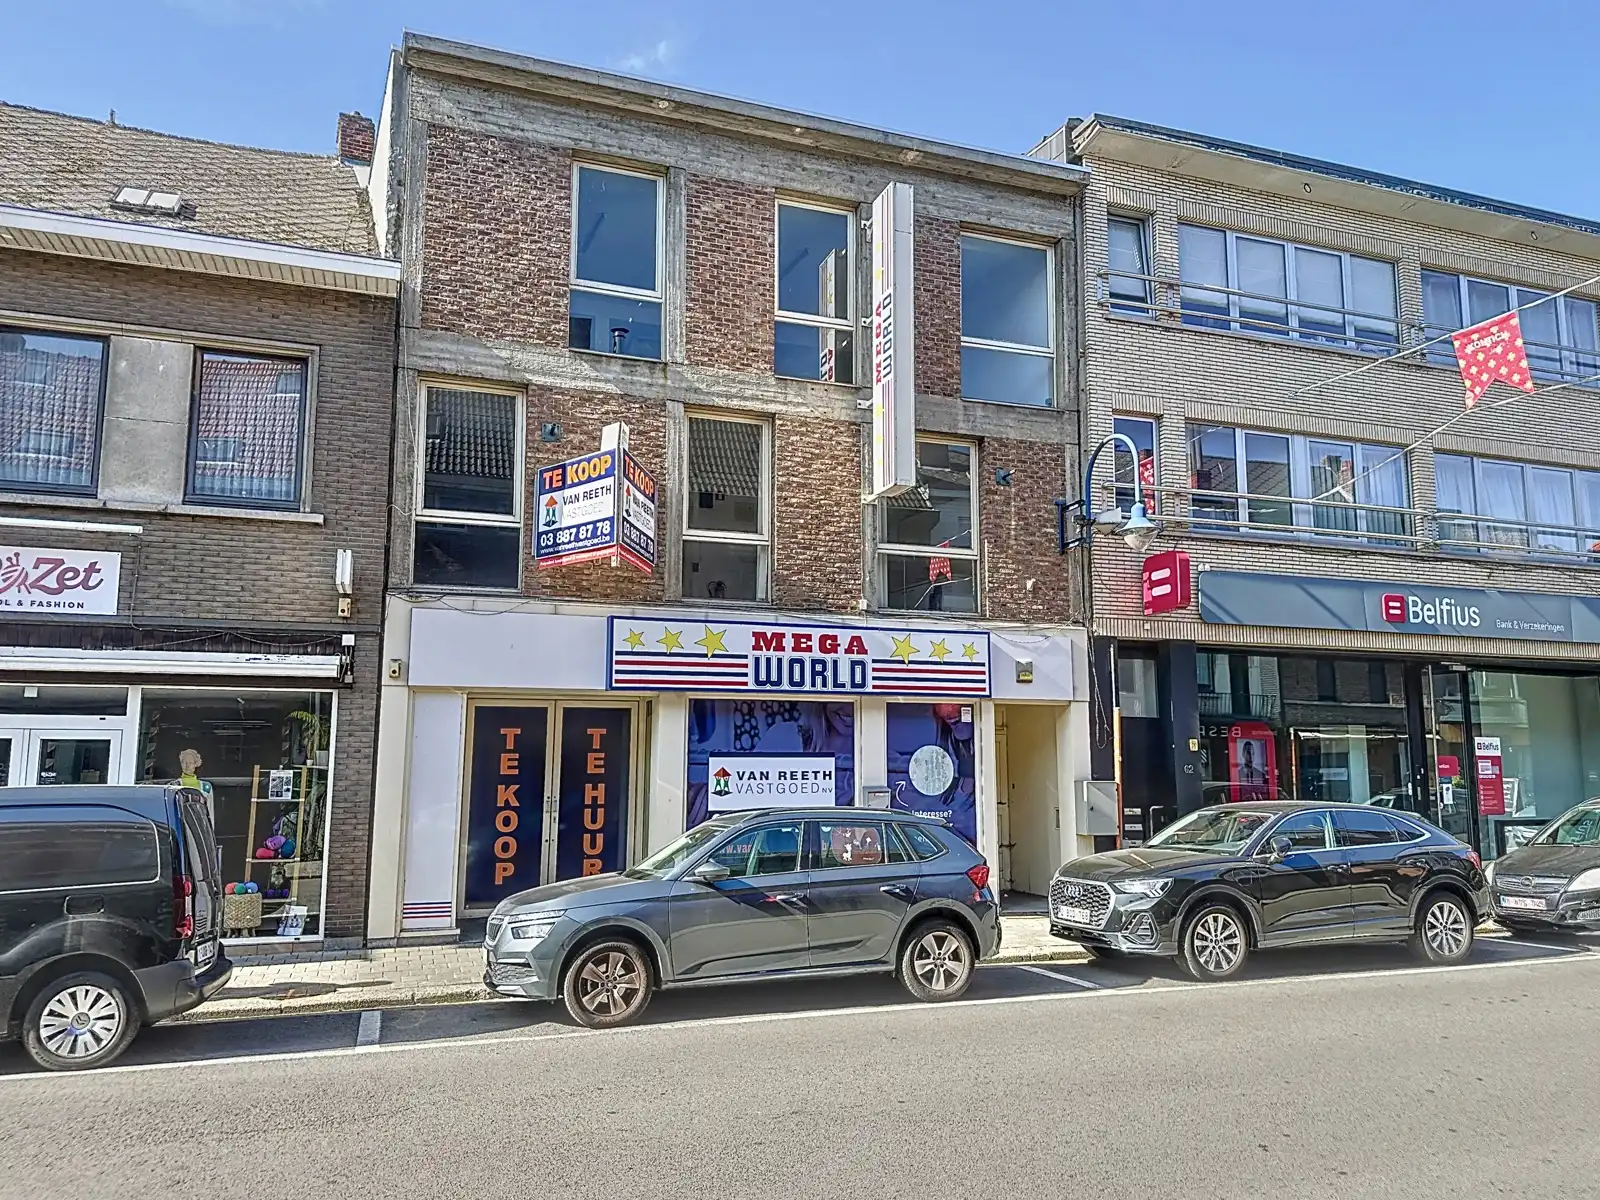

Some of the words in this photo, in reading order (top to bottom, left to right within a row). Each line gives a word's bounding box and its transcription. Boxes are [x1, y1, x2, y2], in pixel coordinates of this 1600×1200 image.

[882, 293, 892, 378] WORLD
[543, 469, 563, 490] TE
[567, 455, 612, 485] KOOP
[624, 455, 634, 481] TE
[634, 467, 654, 498] KOOP
[562, 493, 580, 506] VAN
[582, 484, 612, 502] REETH
[540, 533, 554, 547] 03
[556, 527, 577, 544] 887
[579, 524, 594, 539] 87
[596, 520, 611, 536] 78
[29, 556, 104, 596] Zet
[16, 599, 24, 607] &
[30, 600, 85, 609] FASHION
[1408, 595, 1481, 627] Belfius
[1496, 619, 1513, 629] Bank
[1513, 620, 1520, 630] &
[1519, 621, 1565, 632] Verzekeringen
[752, 631, 869, 655] MEGA
[752, 655, 869, 690] WORLD
[500, 728, 521, 775] TE
[586, 728, 607, 774] TE
[1482, 742, 1499, 751] Belfius
[736, 770, 770, 781] VAN
[778, 770, 833, 781] REETH
[1183, 764, 1194, 774] 62
[735, 782, 820, 795] VASTGOED
[582, 783, 606, 877] HUUR
[911, 809, 953, 818] Interesse?
[493, 784, 521, 885] KOOP
